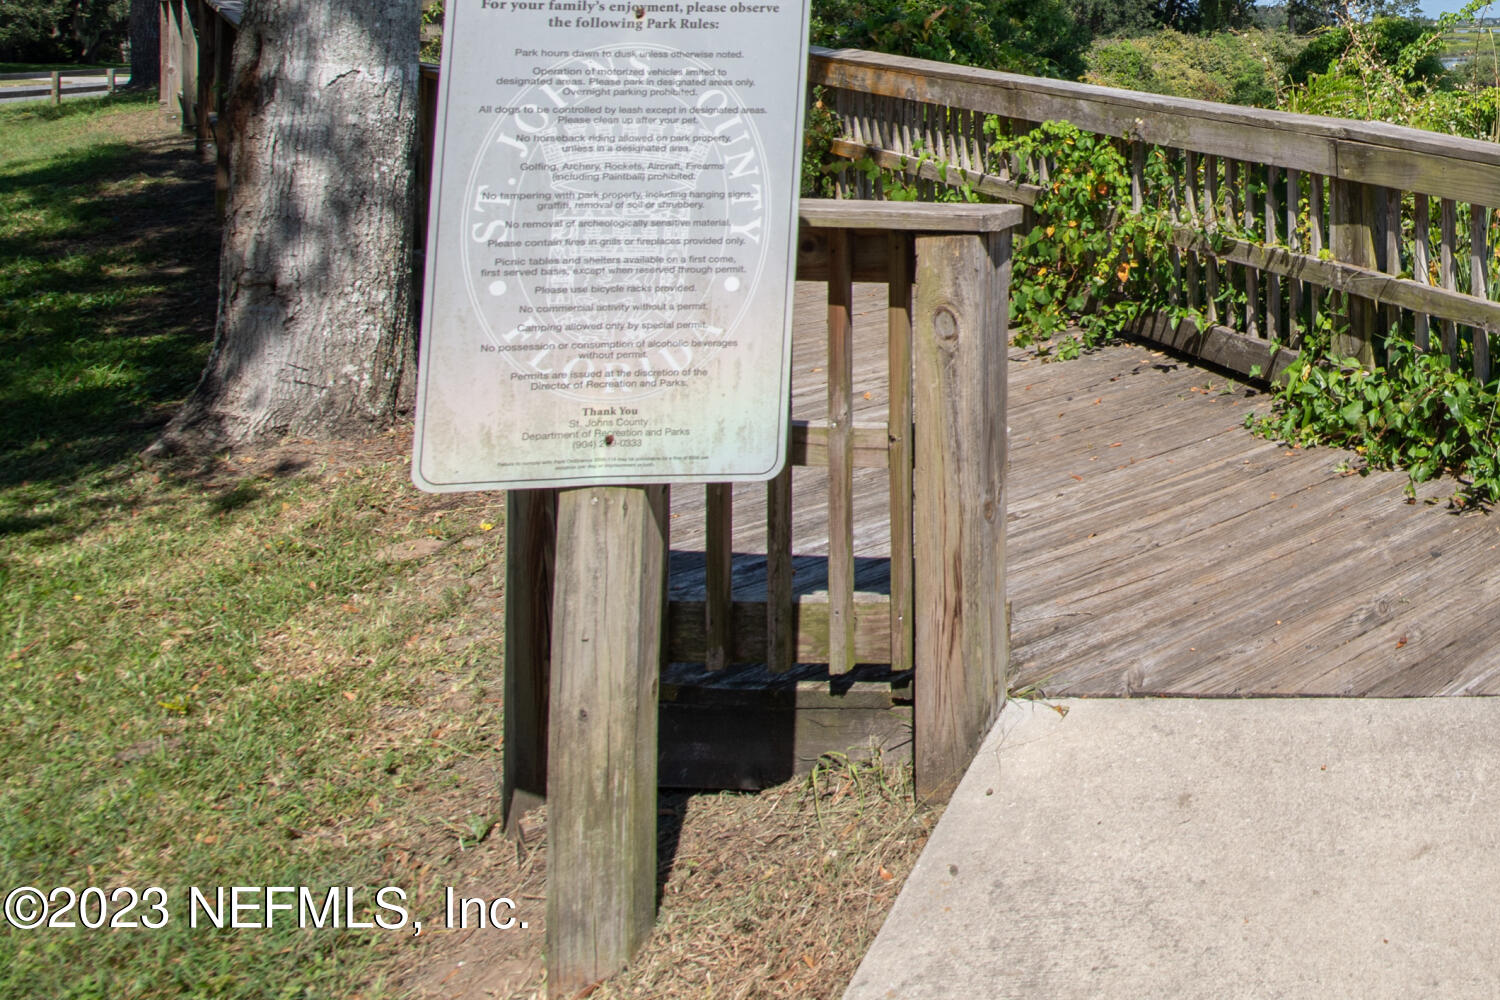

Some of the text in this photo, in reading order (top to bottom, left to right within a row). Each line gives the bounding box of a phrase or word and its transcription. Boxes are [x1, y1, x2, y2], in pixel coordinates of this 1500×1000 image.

[482, 0, 506, 10] For
[510, 2, 544, 13] your
[686, 1, 726, 15] please
[730, 2, 780, 13] observe
[548, 17, 720, 31] the following Park Rules:
[514, 48, 537, 57] Park
[540, 49, 569, 57] hours
[572, 49, 599, 57] dawn
[671, 49, 713, 58] otherwise
[715, 50, 744, 58] noted.
[532, 67, 582, 78] Operation
[585, 67, 595, 75] of
[717, 68, 728, 76] to
[496, 77, 552, 88] designated
[588, 77, 621, 86] Please
[624, 77, 642, 88] park
[646, 77, 654, 86] in
[657, 77, 706, 88] designated
[735, 78, 756, 88] only.
[562, 88, 610, 98] Overnight
[612, 88, 647, 98] parking
[478, 105, 491, 113] All
[494, 105, 520, 116] dogs
[523, 105, 533, 113] to
[536, 105, 549, 113] be
[552, 105, 602, 114] controlled
[604, 105, 616, 116] by
[618, 105, 643, 114] leash
[645, 105, 676, 116] except
[678, 105, 686, 114] in
[690, 105, 738, 116] designated
[558, 115, 698, 126] Please clean up after your pet.
[516, 134, 530, 142] No
[533, 134, 585, 142] horseback
[618, 134, 654, 142] allowed
[669, 134, 690, 144] park
[616, 144, 666, 154] designated
[686, 162, 724, 170] Firearms
[482, 190, 496, 198] No
[554, 190, 574, 198] with
[575, 190, 598, 200] park
[689, 190, 725, 200] hanging
[575, 201, 612, 209] removal
[615, 201, 624, 209] of
[657, 200, 704, 211] shrubbery.
[504, 220, 519, 228] No
[522, 220, 562, 228] removal
[651, 219, 690, 227] sensitive
[488, 239, 522, 247] Please
[637, 237, 680, 248] fireplaces
[683, 237, 723, 248] provided
[725, 236, 746, 247] only.
[494, 257, 525, 266] Picnic
[529, 257, 559, 265] tables
[624, 256, 664, 264] available
[688, 255, 706, 264] first
[708, 257, 736, 265] come,
[480, 265, 746, 276] first served through permit.
[534, 285, 568, 294] Please
[590, 284, 624, 295] bicycle
[626, 284, 652, 293] racks
[518, 304, 533, 313] No
[535, 304, 594, 313] commercial
[632, 303, 666, 311] without
[518, 323, 562, 334] Camping
[565, 322, 602, 331] allowed
[628, 322, 638, 332] by
[641, 321, 674, 332] special
[480, 344, 495, 352] No
[497, 342, 555, 354] possession
[570, 341, 634, 353] consumption
[635, 340, 645, 349] of
[690, 338, 738, 350] beverages
[578, 350, 614, 359] without
[510, 371, 549, 380] Permits
[570, 370, 602, 379] issued
[605, 370, 614, 378] at
[616, 369, 631, 378] the
[633, 368, 679, 378] discretion
[681, 368, 691, 377] of
[693, 368, 708, 376] the
[530, 382, 571, 391] Director
[573, 381, 582, 390] of
[585, 380, 637, 389] Recreation
[639, 380, 657, 388] and
[582, 407, 638, 416] Thank You
[585, 419, 613, 428] Johns
[615, 418, 648, 429] County
[522, 431, 578, 443] Department
[582, 431, 591, 439] of
[645, 428, 662, 437] and
[664, 427, 690, 436] Parks
